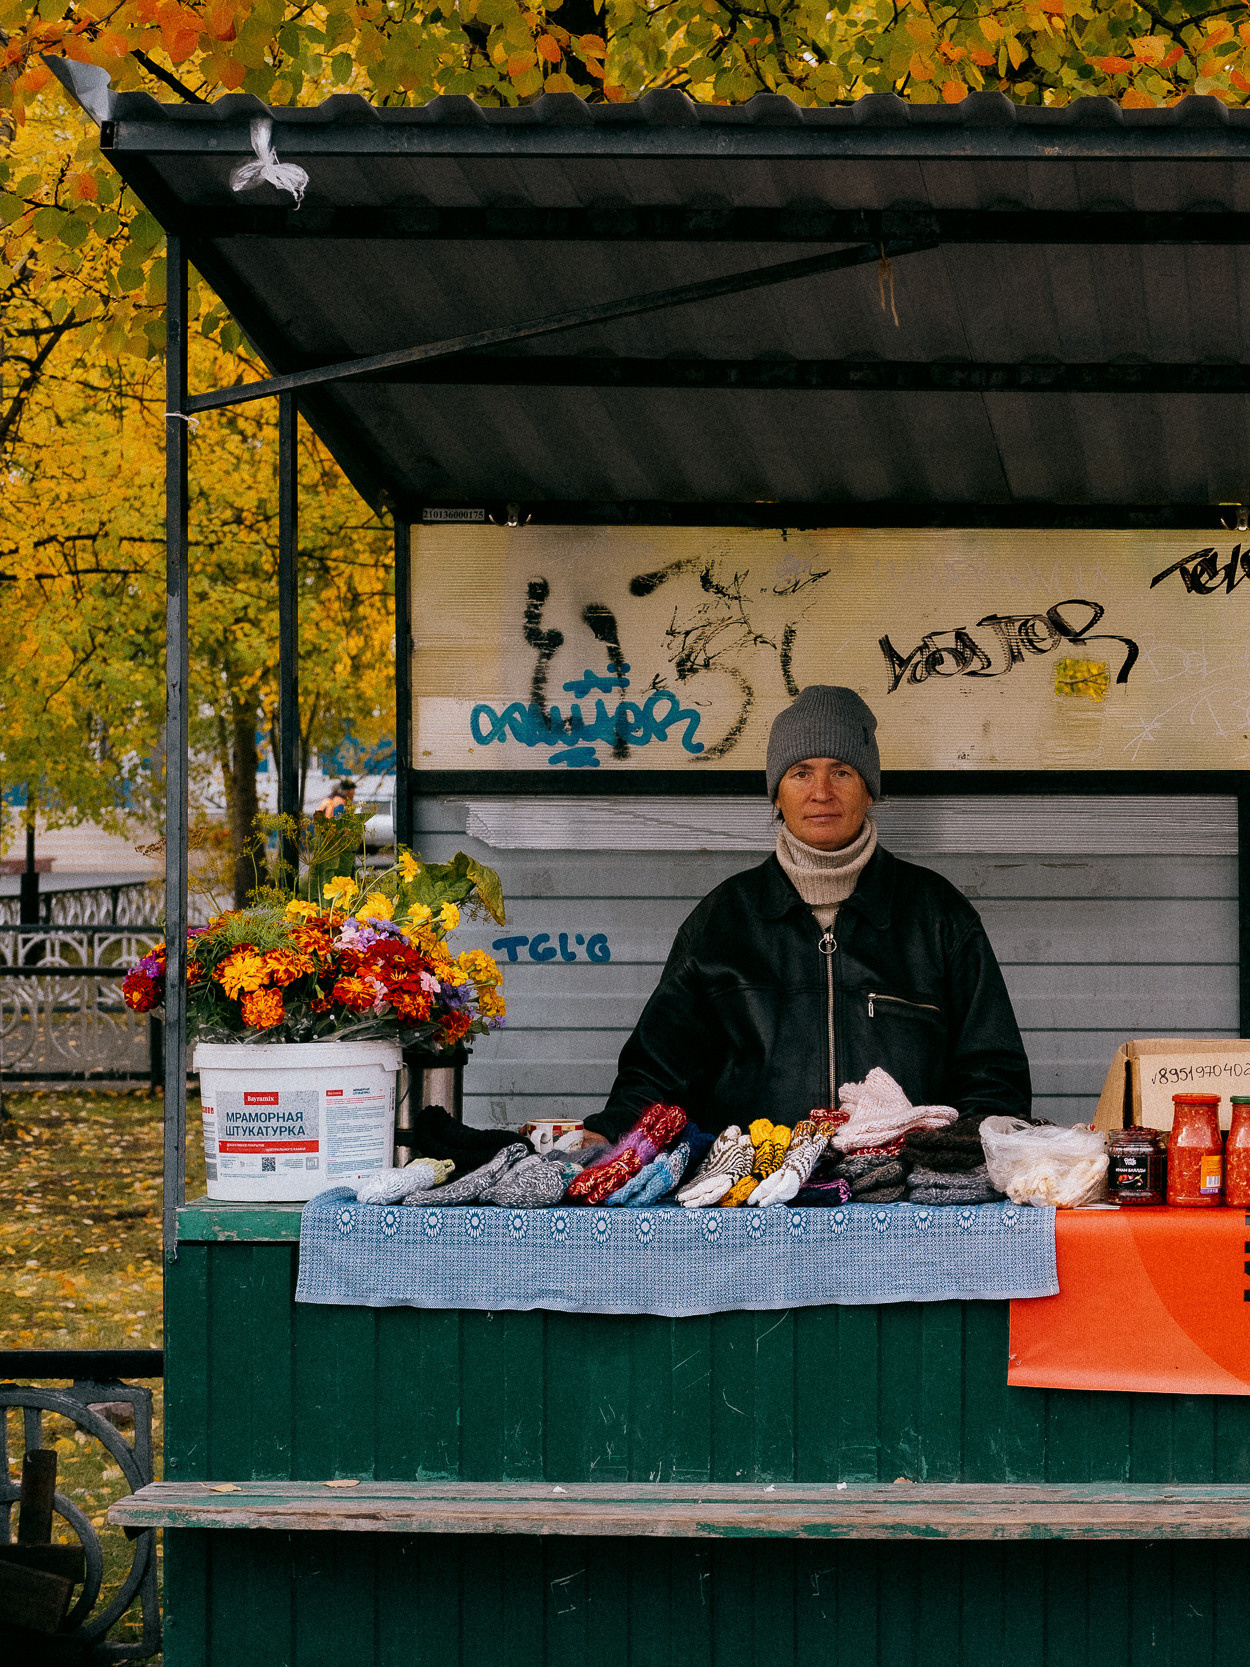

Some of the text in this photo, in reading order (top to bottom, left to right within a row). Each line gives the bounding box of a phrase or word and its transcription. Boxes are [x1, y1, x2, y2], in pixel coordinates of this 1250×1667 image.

[423, 510, 484, 519] 210136000175
[226, 1111, 304, 1123] МРАМОРНАЯ
[225, 1125, 306, 1137] ШТУКАТУРКА
